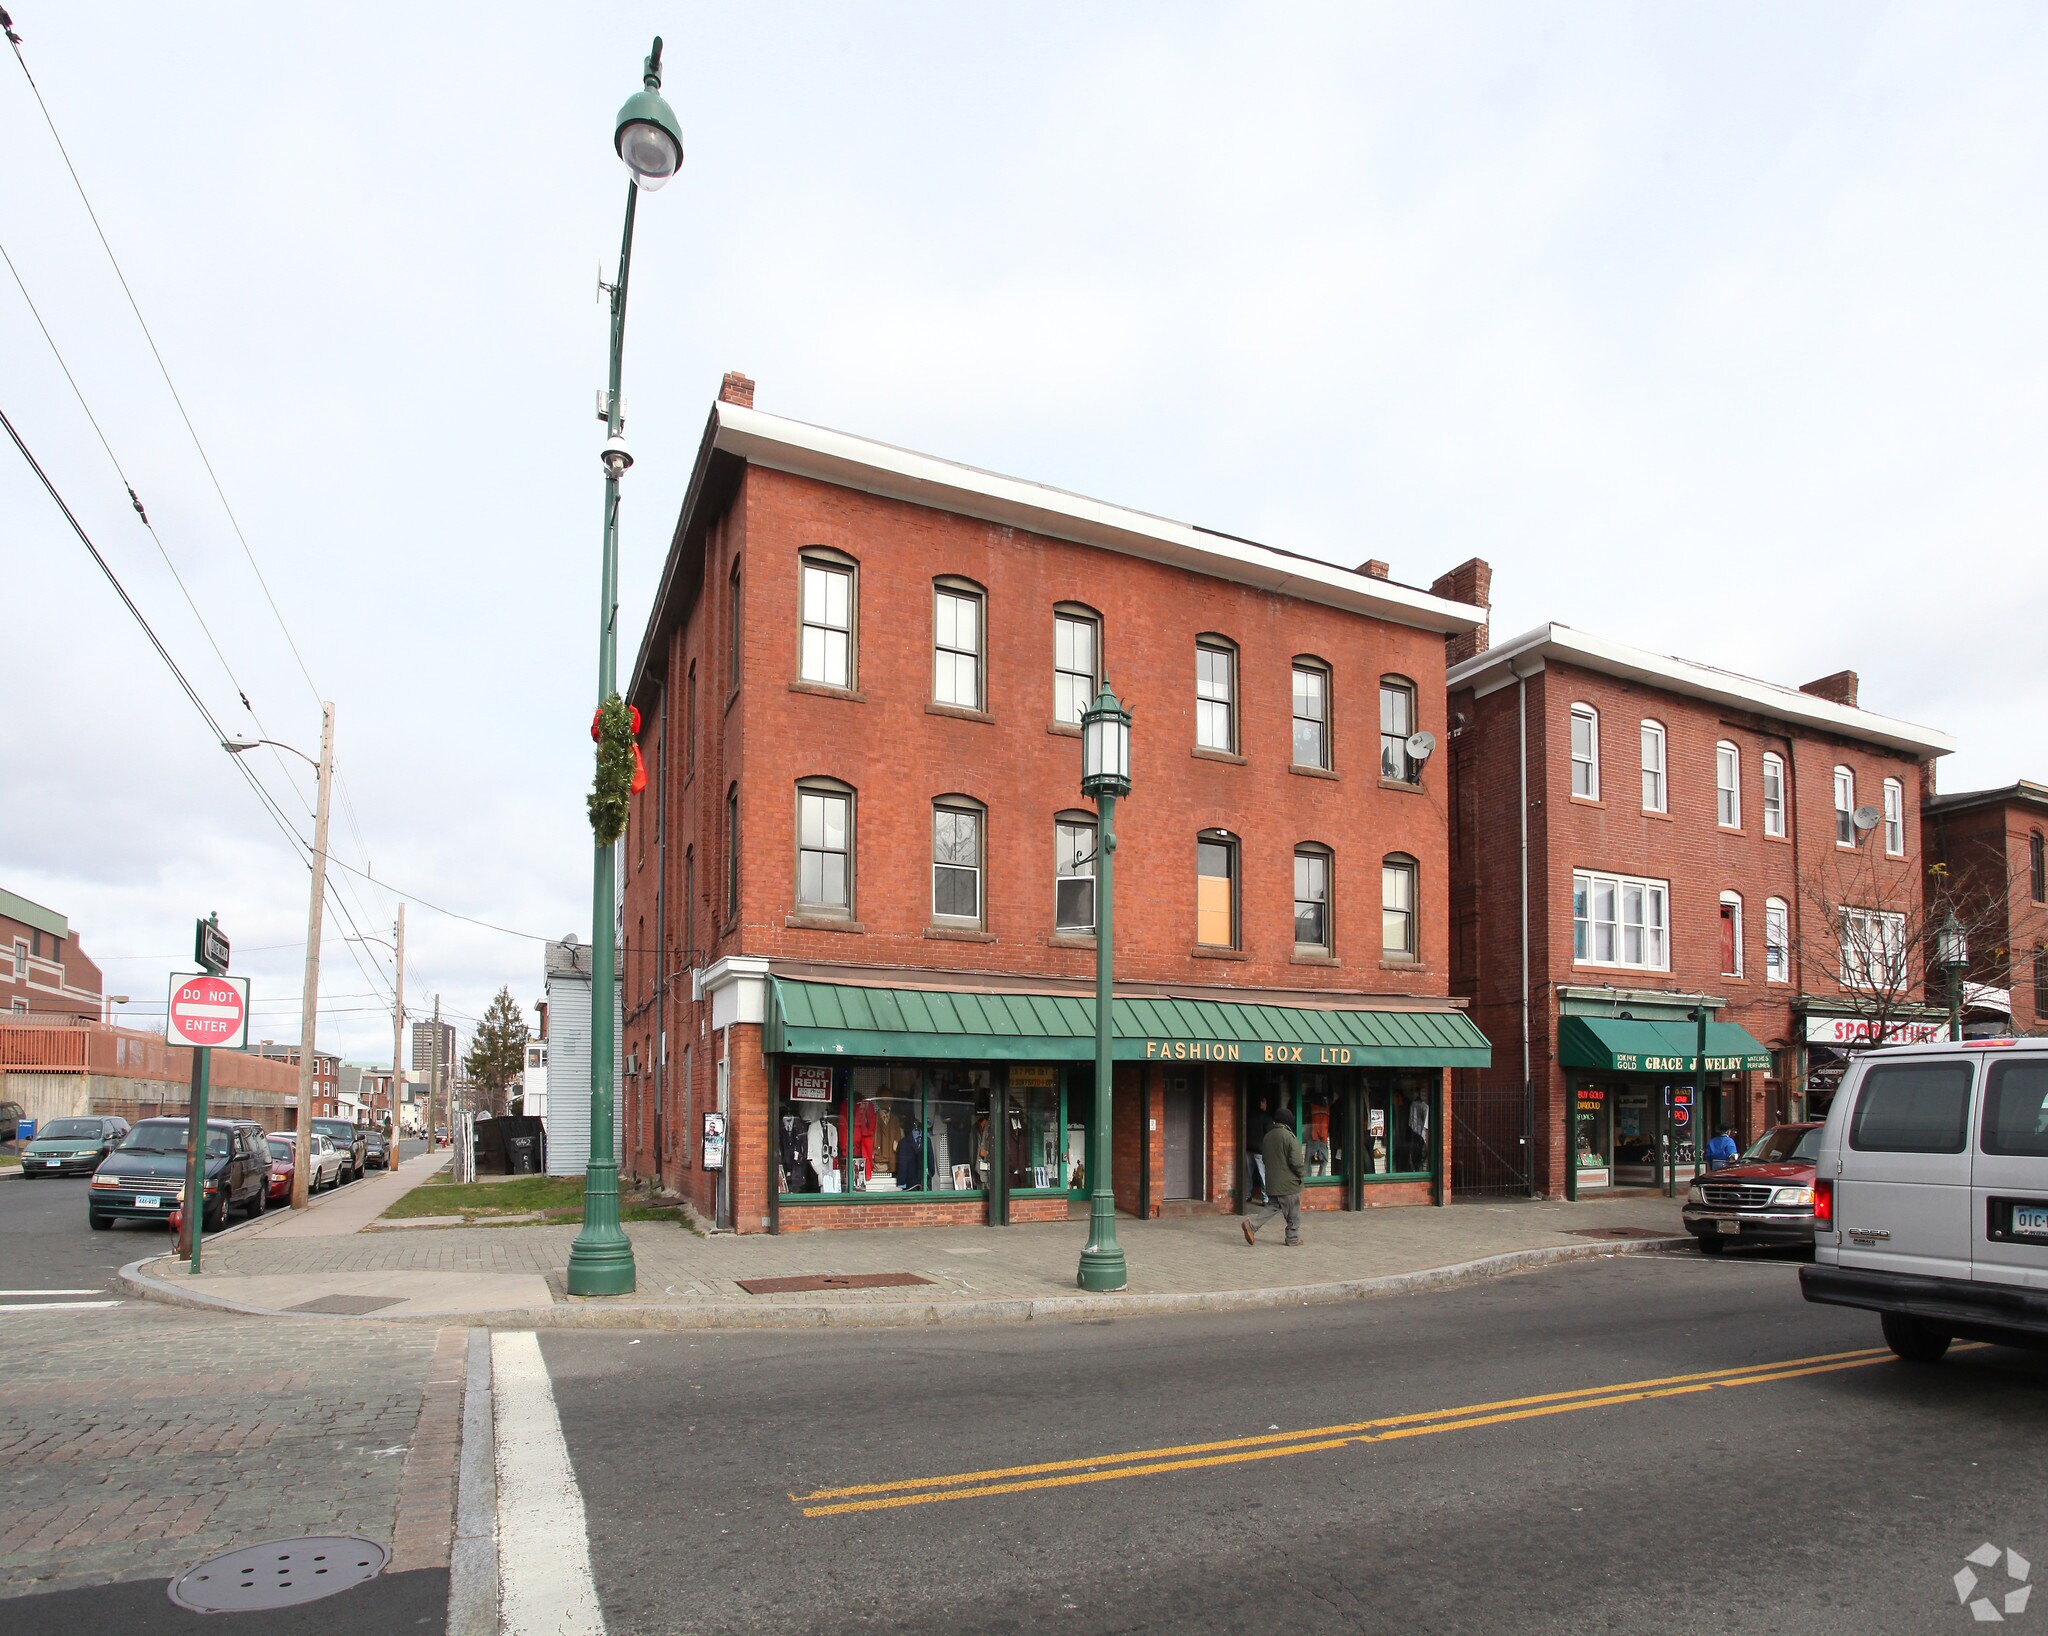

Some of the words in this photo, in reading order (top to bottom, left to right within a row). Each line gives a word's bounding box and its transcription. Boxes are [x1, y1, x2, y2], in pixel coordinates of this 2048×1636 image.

[183, 989, 201, 1000] DO
[209, 991, 235, 1003] NOT
[185, 1019, 227, 1033] ENTER
[1146, 1041, 1240, 1060] FASHION
[1264, 1045, 1303, 1062] BOX
[1320, 1047, 1351, 1064] LTD
[1617, 1061, 1637, 1070] GOLD
[1645, 1056, 1683, 1070] GRACE
[1689, 1057, 1742, 1070] JWELRY
[799, 1068, 825, 1079] FOR
[794, 1077, 829, 1088] RENT
[1577, 1090, 1588, 1099] BUY
[1589, 1090, 1604, 1100] GOLD
[1674, 1110, 1687, 1121] PEN
